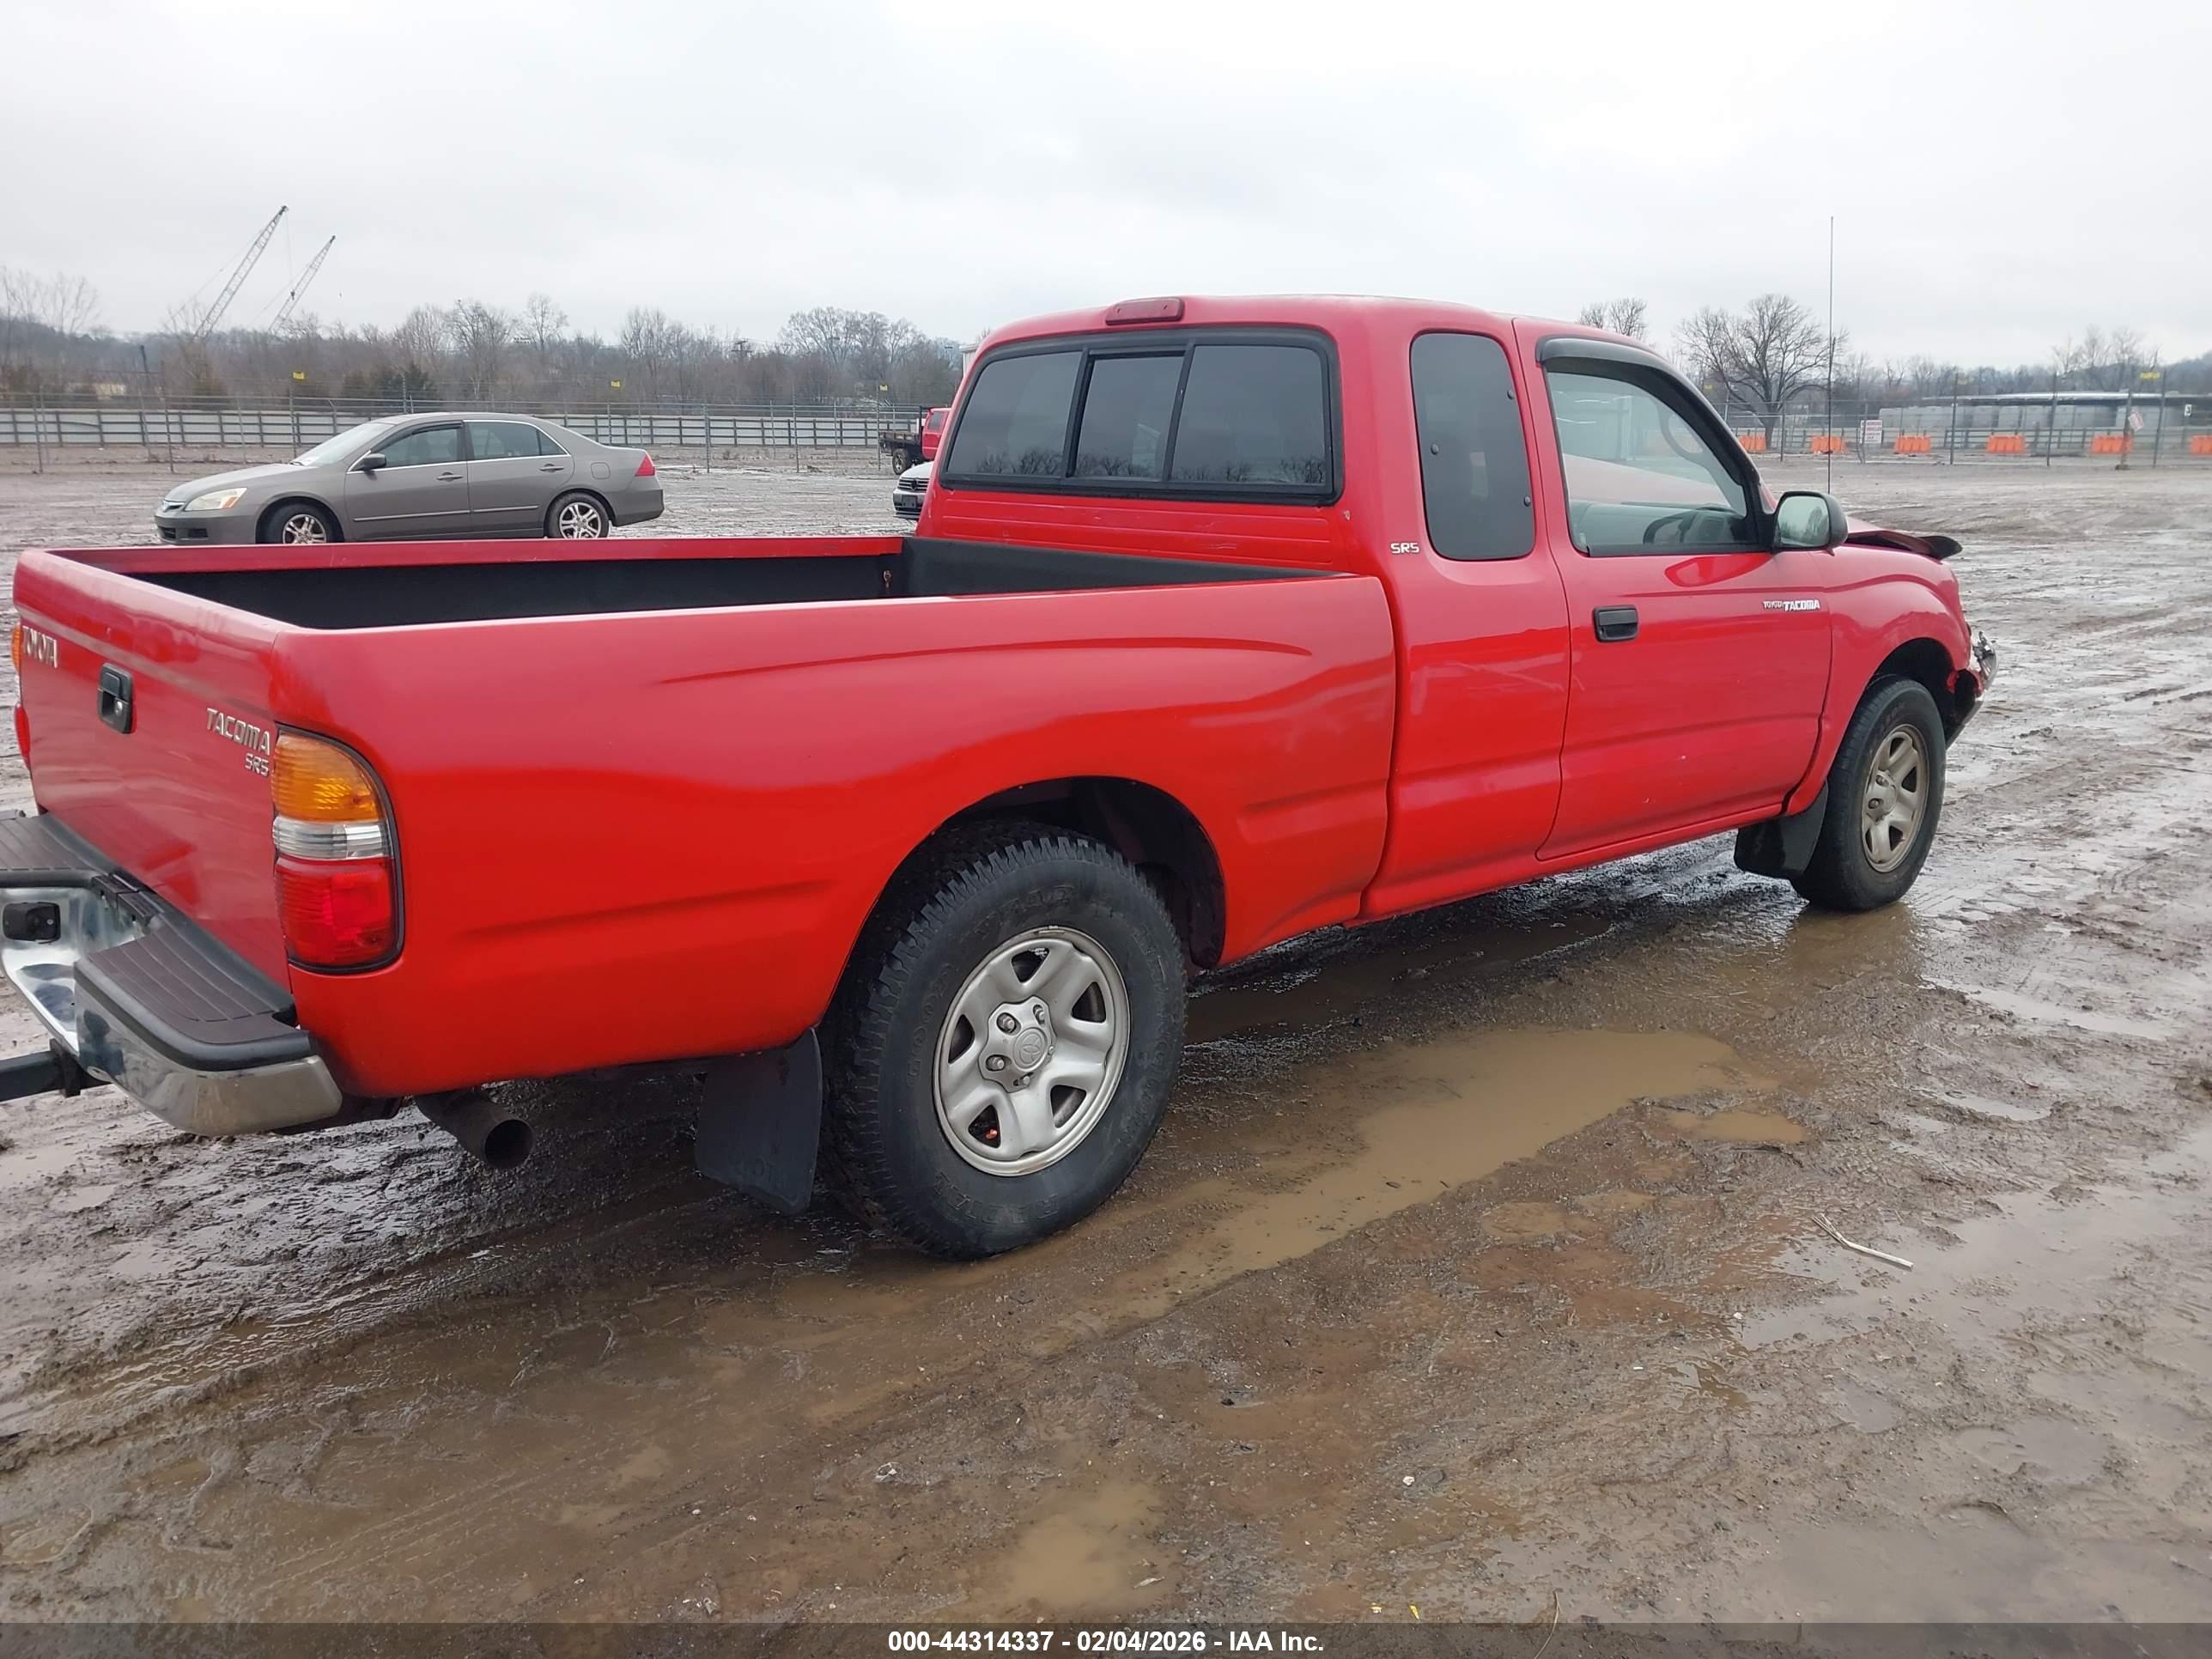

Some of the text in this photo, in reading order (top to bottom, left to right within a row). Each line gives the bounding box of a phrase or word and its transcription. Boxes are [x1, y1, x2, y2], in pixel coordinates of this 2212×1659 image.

[1390, 542, 1420, 555] SR5
[1784, 599, 1820, 612] TACOMA
[206, 707, 271, 757] TACOMA
[244, 752, 270, 777] SR5
